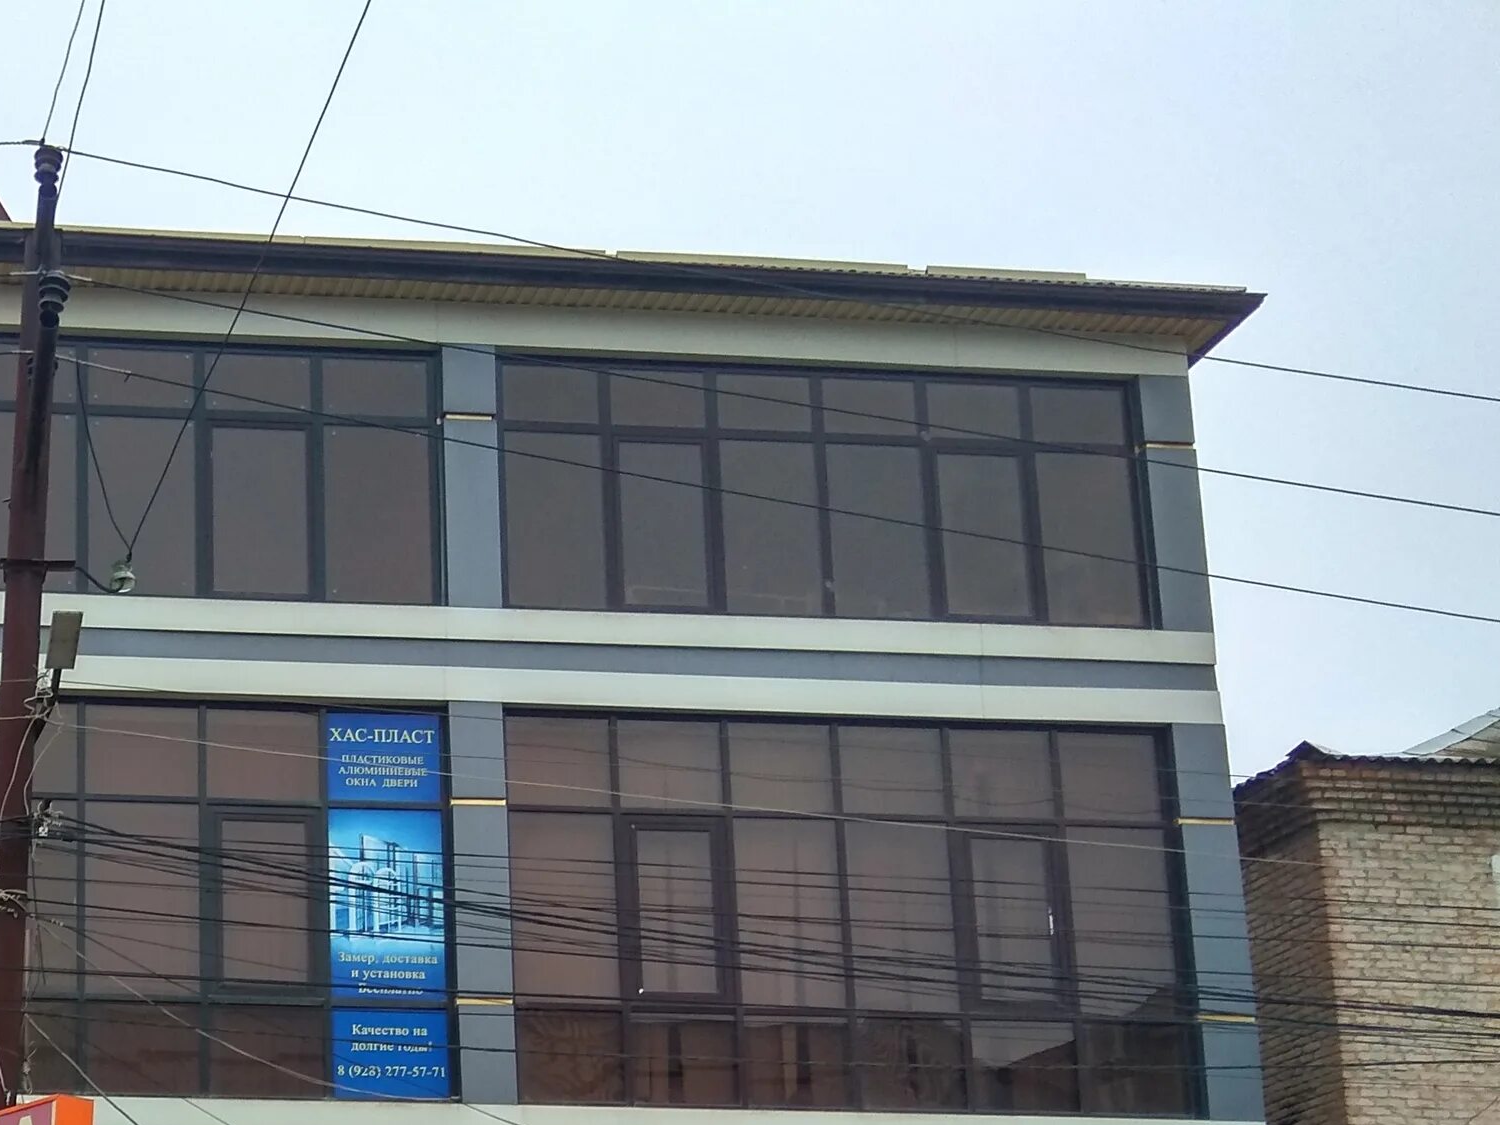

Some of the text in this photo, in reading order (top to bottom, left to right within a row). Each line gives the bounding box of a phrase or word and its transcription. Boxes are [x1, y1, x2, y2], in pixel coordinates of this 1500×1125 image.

[329, 727, 435, 744] ХАС-ПЛАСТ
[341, 754, 424, 765] ПЛАСТИКОВЫЕ
[338, 766, 428, 776] АЛЮМИНИЕВЫЕ
[345, 777, 418, 788] ОКНА ДВЕРИ
[382, 954, 438, 965] доставка
[351, 969, 426, 980] и установка
[351, 1024, 428, 1036] Качество на
[350, 1041, 394, 1052] долгие
[337, 1065, 345, 1077] 8
[384, 1065, 446, 1078] 277-57-71
